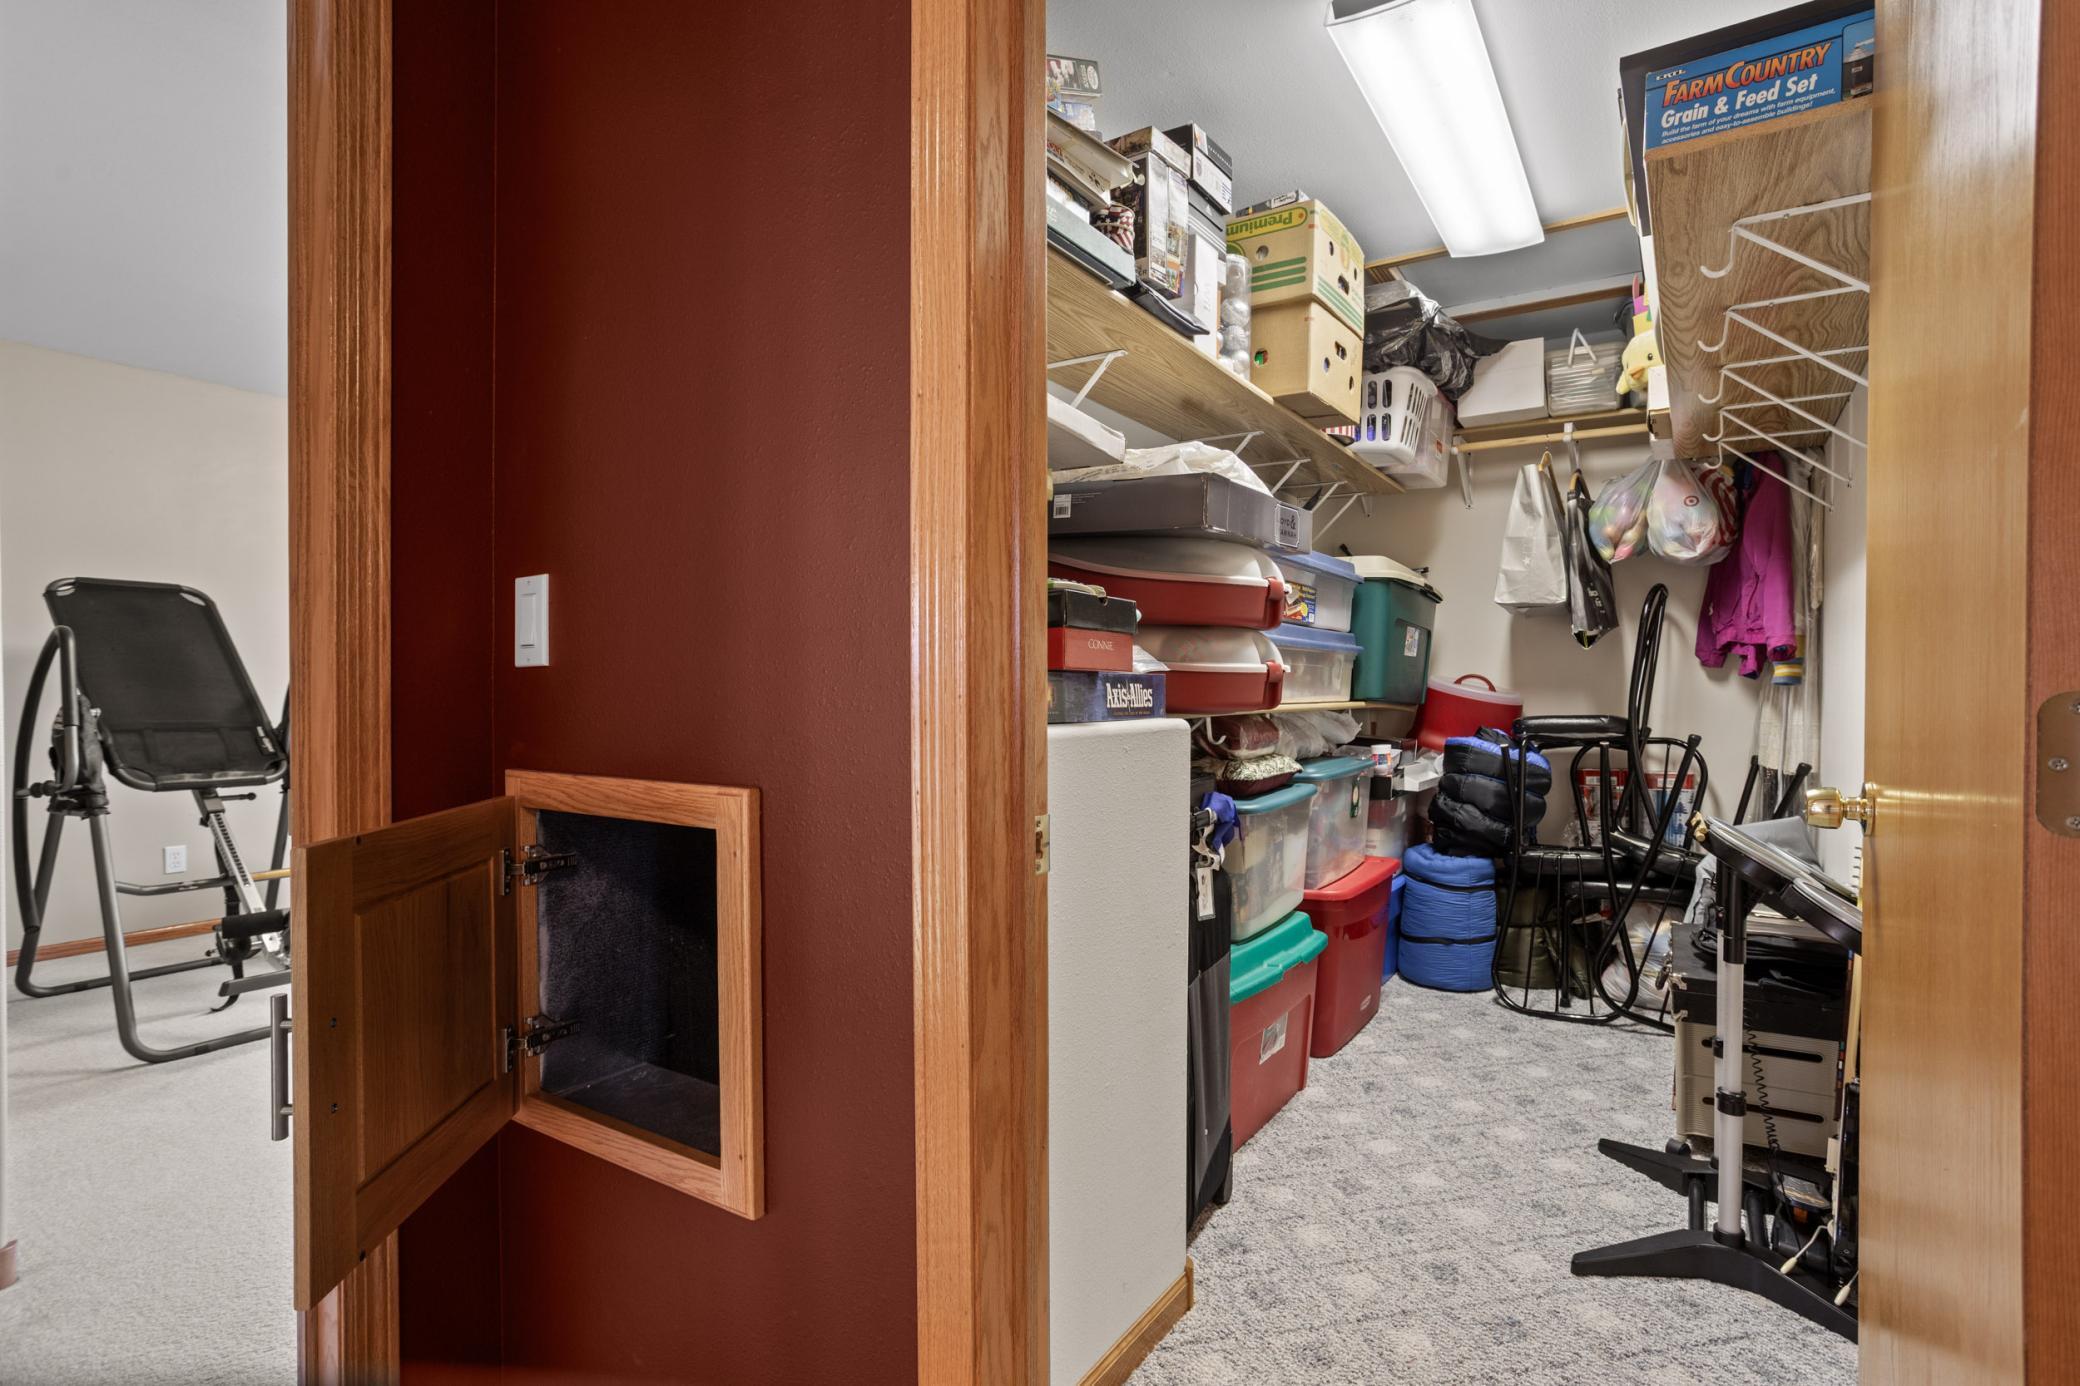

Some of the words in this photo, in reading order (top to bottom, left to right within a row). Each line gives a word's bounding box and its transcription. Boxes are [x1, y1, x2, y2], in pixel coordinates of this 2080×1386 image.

[1661, 103, 1709, 128] Grain
[1714, 96, 1729, 115] &
[1735, 80, 1781, 110] Feed
[1785, 73, 1818, 97] Set
[1661, 128, 1679, 138] Build
[1680, 125, 1690, 133] the
[1692, 121, 1707, 130] farm
[1708, 118, 1716, 126] of
[1716, 115, 1732, 124] your
[1733, 109, 1759, 119] dreams
[1761, 103, 1776, 113] with
[1777, 99, 1793, 108] farm
[1794, 88, 1836, 104] equipment,
[1661, 131, 1700, 144] accessories
[1701, 126, 1715, 135] and
[1715, 111, 1776, 131] easy-to-assemble
[1776, 101, 1813, 116] buildings!
[1226, 212, 1293, 236] Premium
[1106, 683, 1127, 708] Axis
[1129, 683, 1153, 708] Allies
